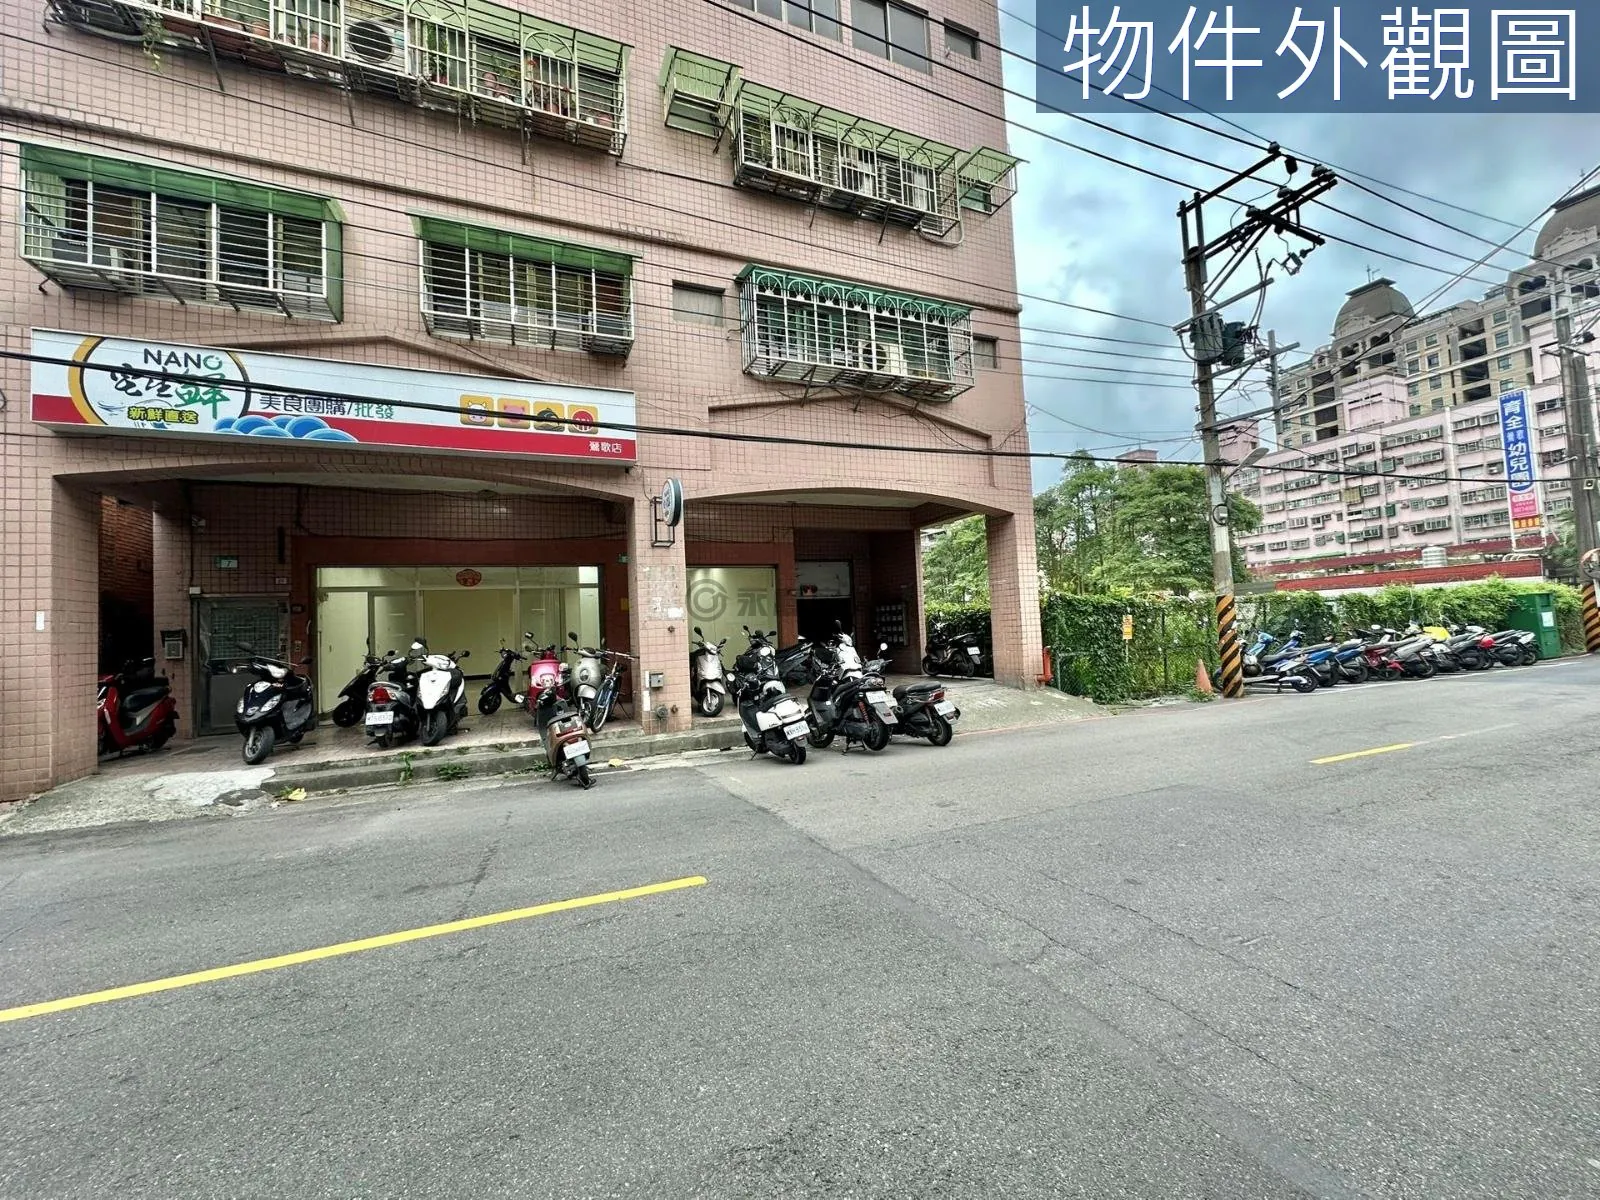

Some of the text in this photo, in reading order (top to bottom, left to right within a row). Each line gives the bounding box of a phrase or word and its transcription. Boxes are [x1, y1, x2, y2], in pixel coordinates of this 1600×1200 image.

[143, 348, 223, 370] NANO
[128, 406, 199, 424] 新鮮直送
